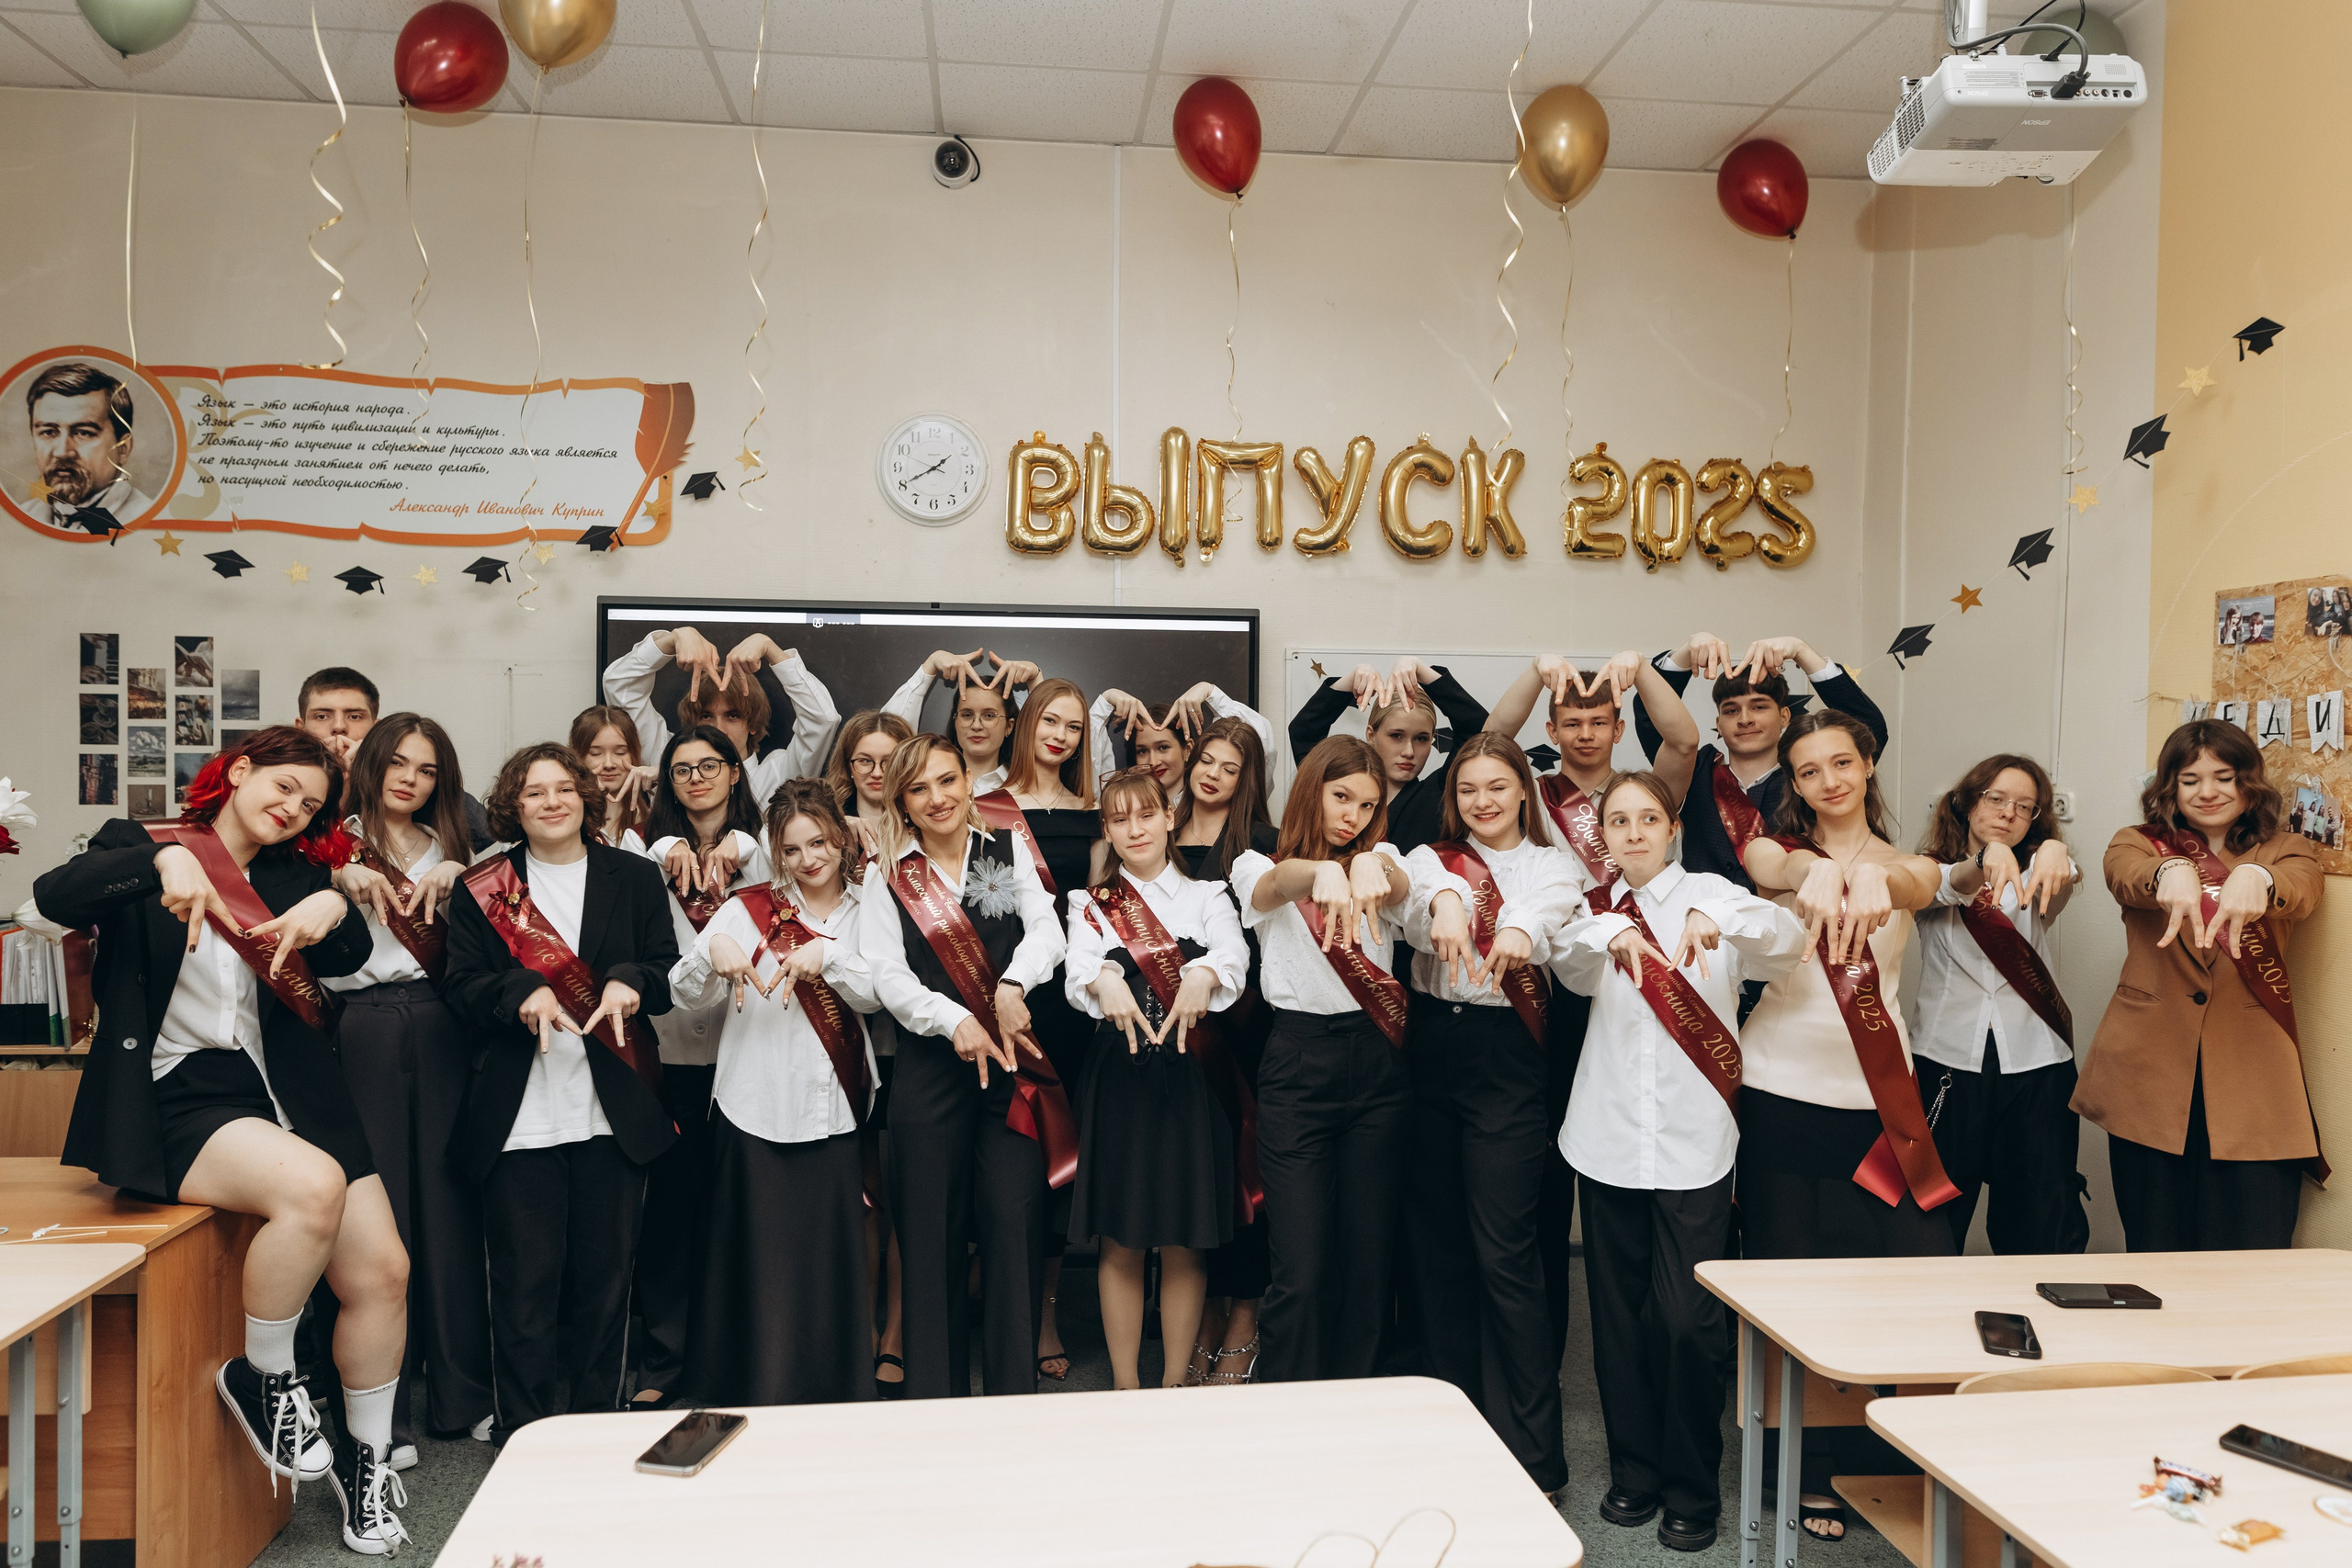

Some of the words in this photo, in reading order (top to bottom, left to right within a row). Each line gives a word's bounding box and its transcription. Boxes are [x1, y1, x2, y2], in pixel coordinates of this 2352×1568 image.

[198, 394, 236, 410] Язык
[260, 400, 287, 411] это
[292, 400, 350, 416] история
[356, 402, 411, 419] народа.
[198, 413, 236, 428] Язык
[260, 418, 287, 430] это
[292, 420, 325, 435] путь
[422, 425, 431, 434] и
[436, 424, 505, 437] культуры.
[928, 427, 941, 439] 12
[910, 431, 921, 443] 11
[198, 432, 288, 450] Поэтому-то
[295, 441, 353, 453] изучение
[356, 443, 366, 451] и
[371, 439, 446, 455] сбережение
[449, 446, 504, 460] русского
[555, 446, 618, 458] является
[897, 444, 910, 456] 10
[960, 446, 969, 457] 2
[198, 455, 215, 465] не
[220, 456, 288, 469] праздным
[294, 459, 364, 470] занятием
[368, 460, 388, 470] от
[393, 462, 433, 472] нечего
[438, 461, 490, 476] делать,
[893, 461, 902, 474] 9
[965, 463, 974, 476] 3
[198, 475, 214, 485] но
[220, 474, 287, 489] насущной
[292, 475, 408, 491] необходимостью.
[899, 479, 908, 491] 8
[961, 481, 967, 493] 4
[911, 493, 920, 505] 7
[929, 498, 938, 511] 6
[947, 494, 956, 506] 5
[1563, 445, 1815, 570] 2025
[390, 497, 469, 515] Александр
[477, 500, 545, 515] Иванович
[551, 502, 605, 521] Куприн
[909, 899, 922, 917] класс
[944, 897, 968, 933] Екатерина
[901, 861, 942, 919] Классный
[932, 918, 988, 994] руководитель
[1683, 989, 1707, 1019] Ксения
[1851, 983, 1889, 1032] 2025
[1701, 1032, 1743, 1079] 2025
